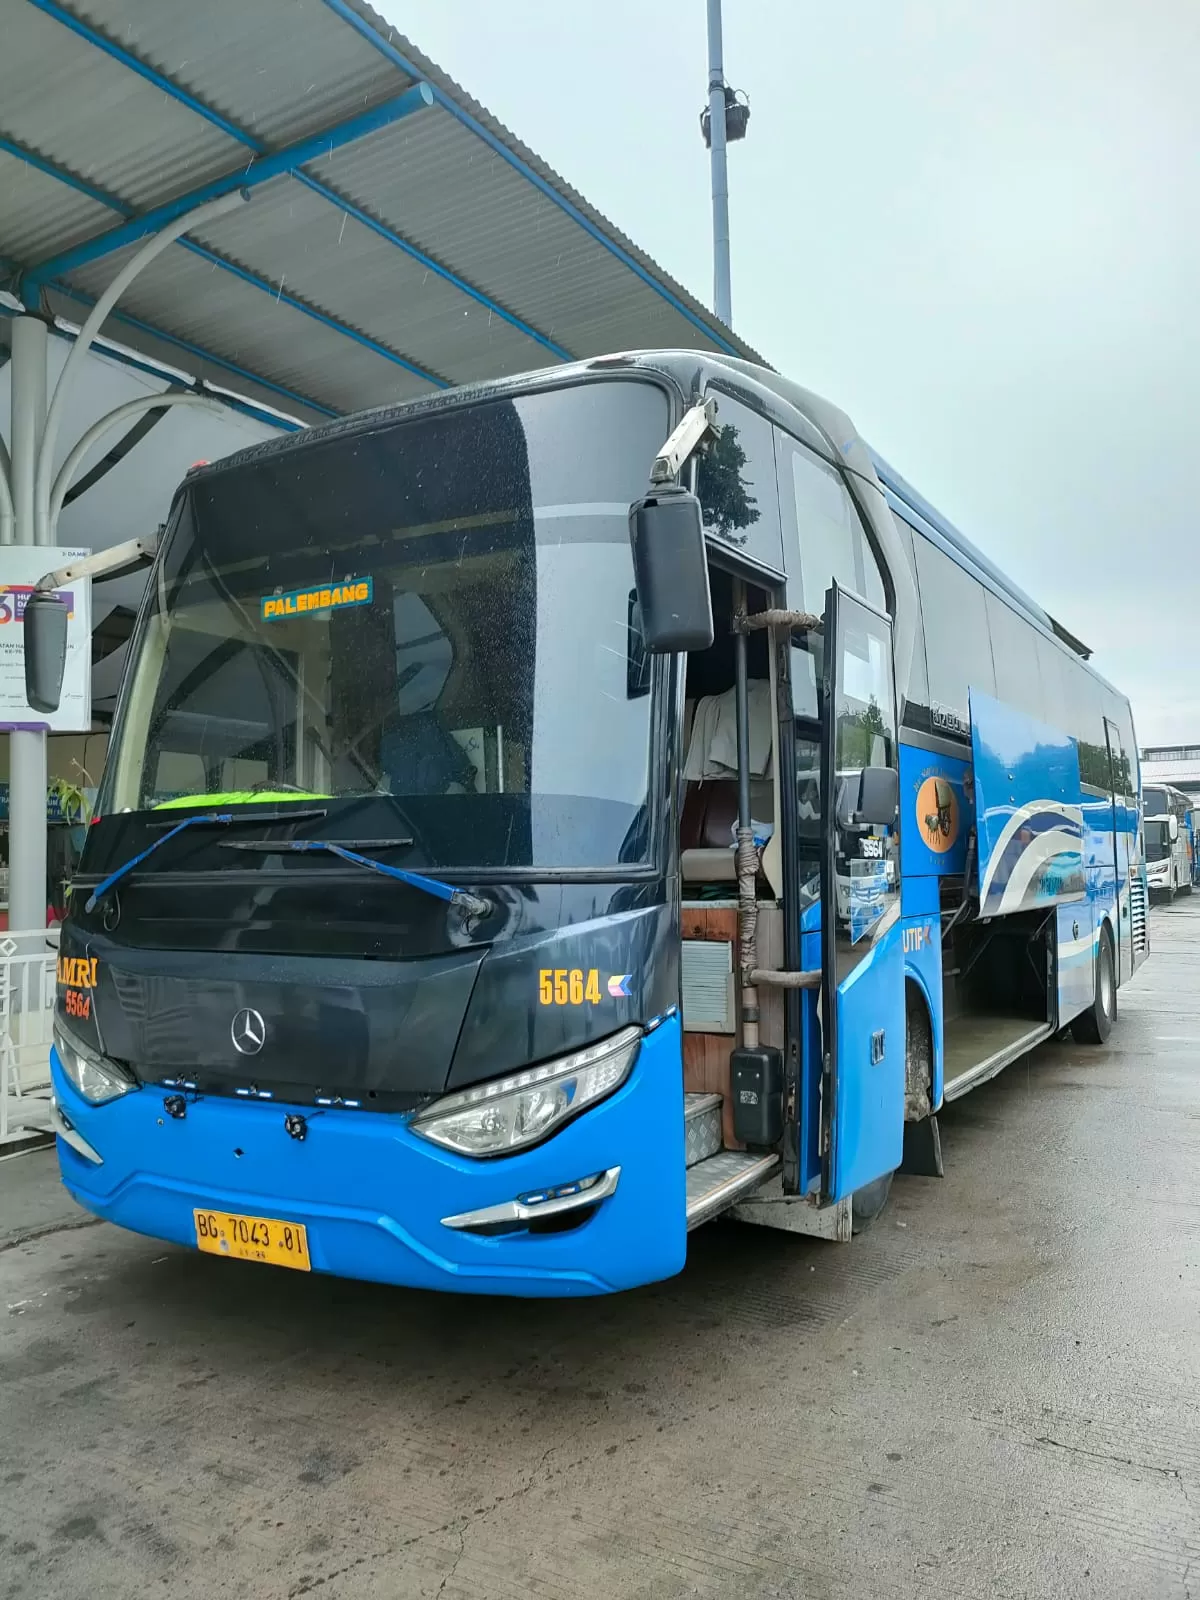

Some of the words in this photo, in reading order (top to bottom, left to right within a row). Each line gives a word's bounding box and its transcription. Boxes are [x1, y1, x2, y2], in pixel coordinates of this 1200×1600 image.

[264, 583, 368, 617] PALEMBANG
[539, 968, 602, 1005] 5564
[65, 989, 91, 1020] 5564
[197, 1214, 218, 1238] BG
[228, 1218, 270, 1246] 7043
